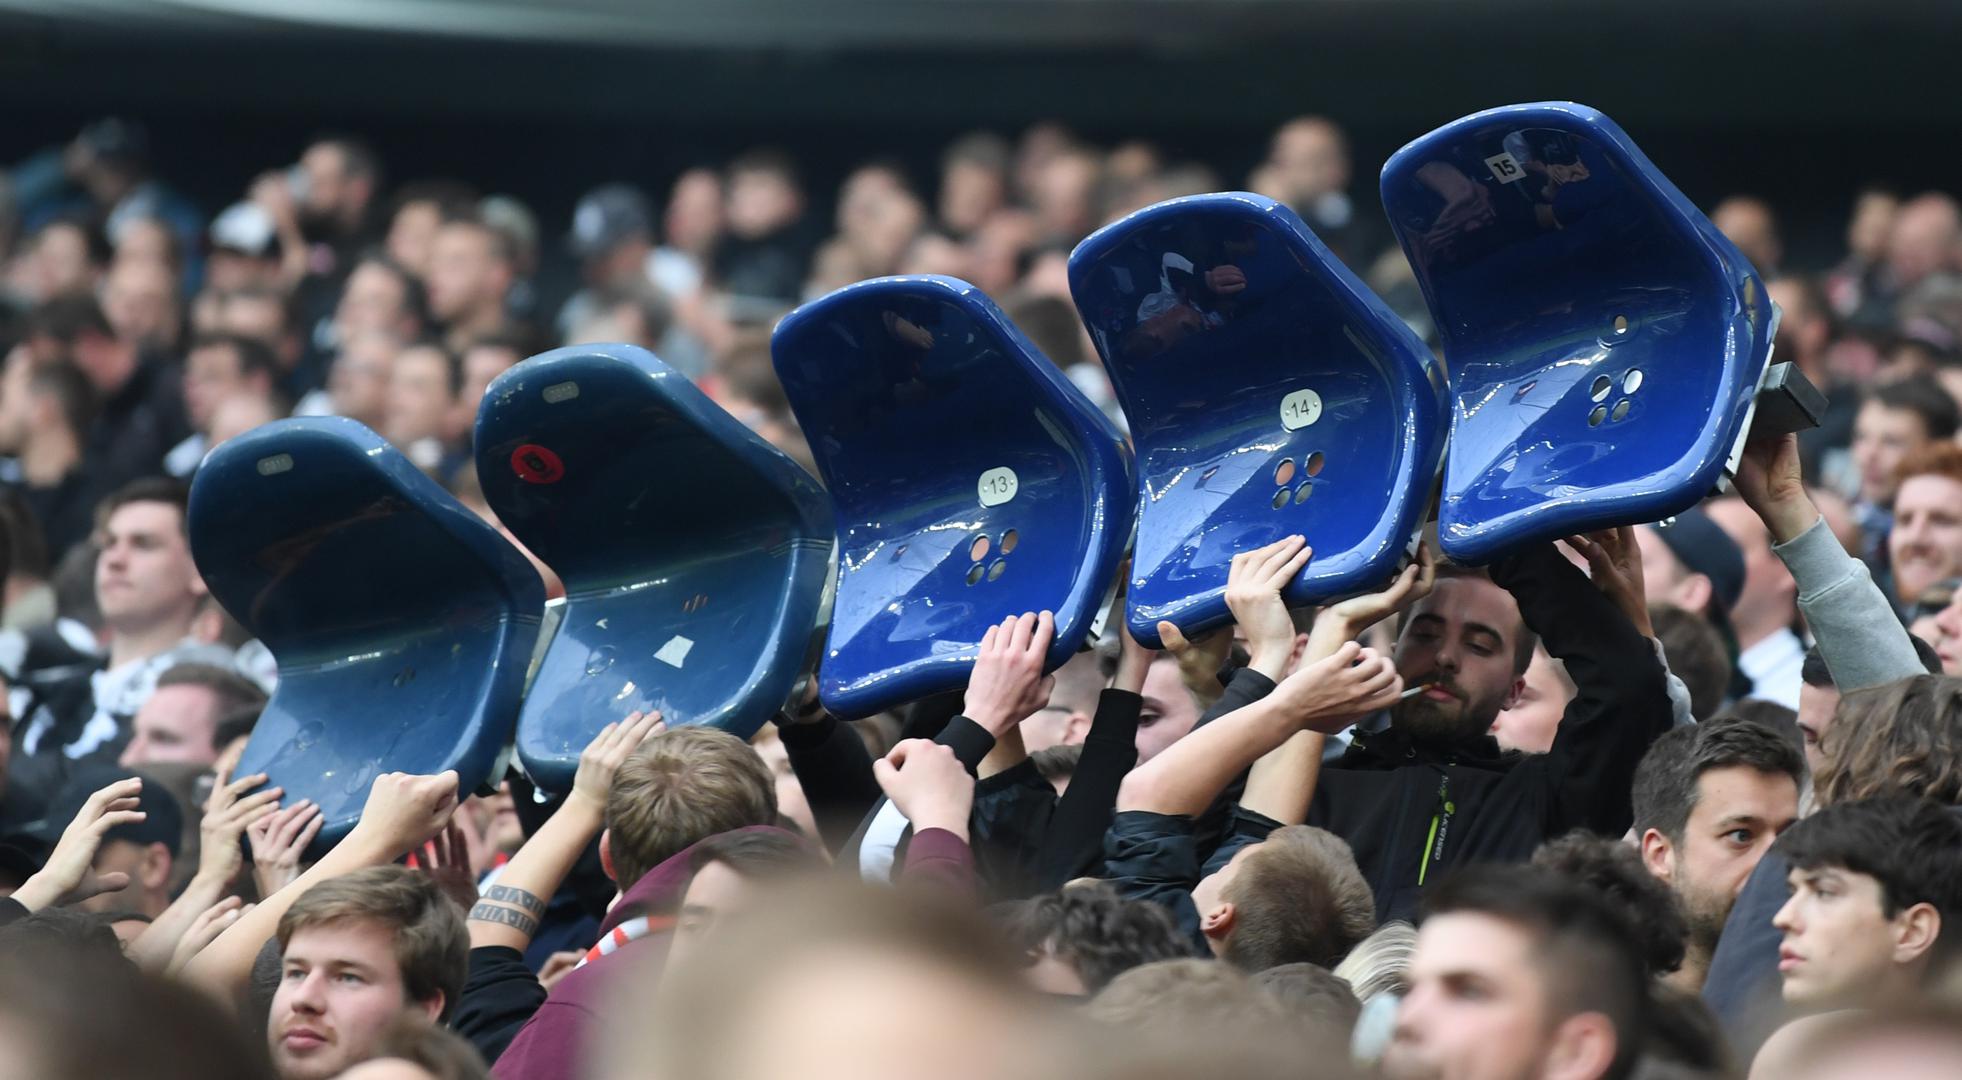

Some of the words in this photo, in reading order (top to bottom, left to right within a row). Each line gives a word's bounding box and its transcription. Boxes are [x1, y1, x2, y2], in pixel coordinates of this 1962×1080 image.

[1493, 158, 1517, 177] 15
[1290, 399, 1310, 418] 14
[990, 475, 1008, 495] 13
